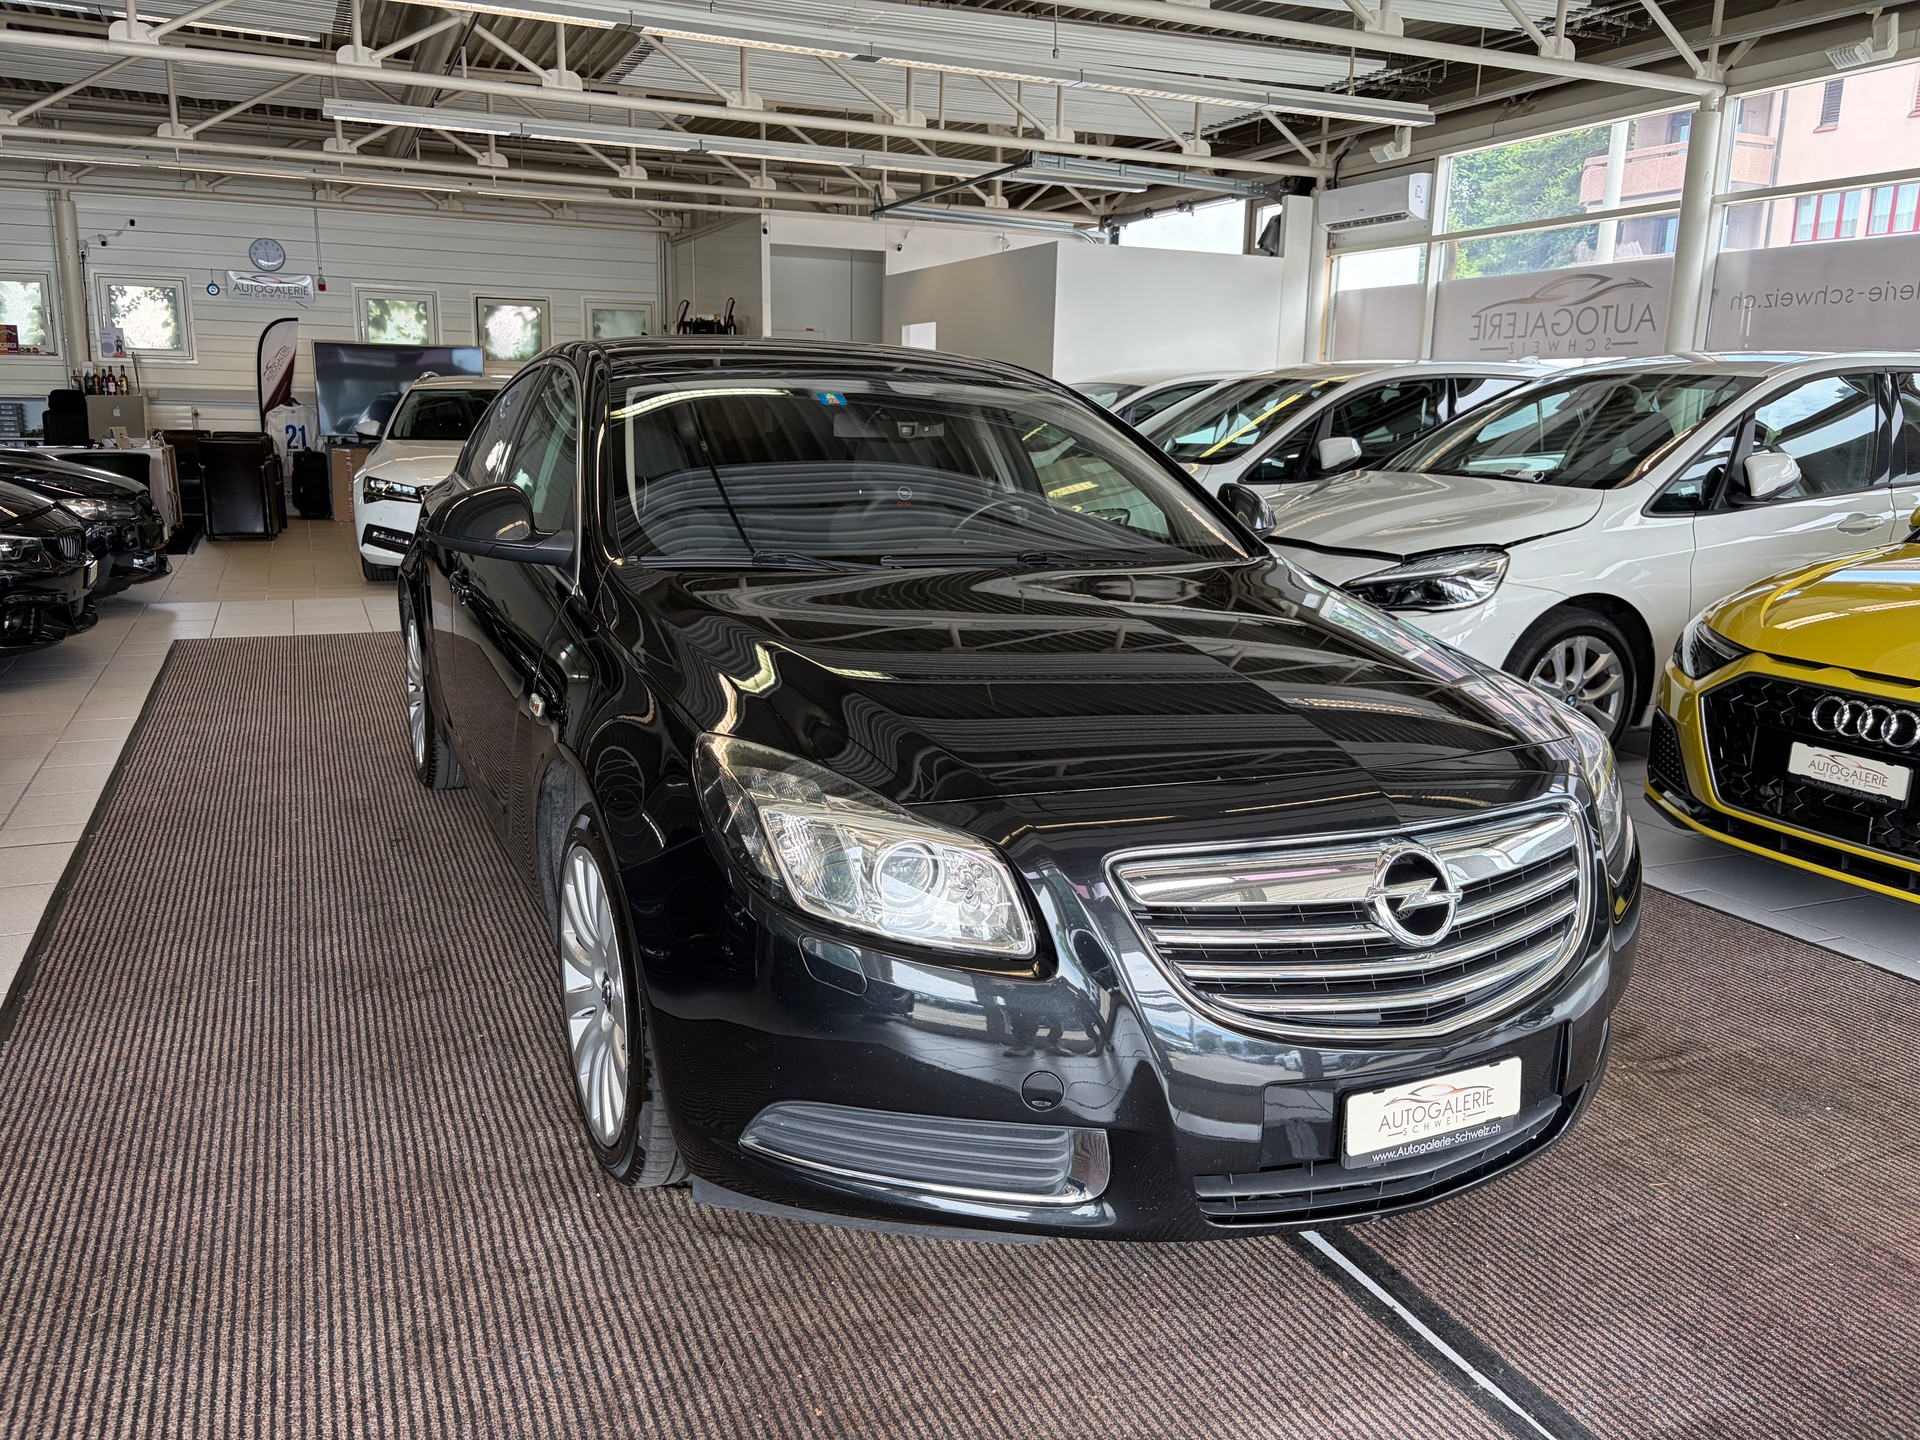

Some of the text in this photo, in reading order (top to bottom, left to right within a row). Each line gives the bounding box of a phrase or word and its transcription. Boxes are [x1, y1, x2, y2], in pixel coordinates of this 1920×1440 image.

[233, 284, 309, 296] AUTOGALERIE
[285, 424, 307, 450] 21
[1808, 759, 1889, 787] AUTOGALERIE
[1823, 772, 1867, 788] SCHWEIZ
[1378, 1087, 1495, 1133] AUTOGALERIE
[1403, 1112, 1467, 1136] SCHWEIZ
[1372, 1124, 1501, 1163] www.Autogalerie-Schweiz.ch
